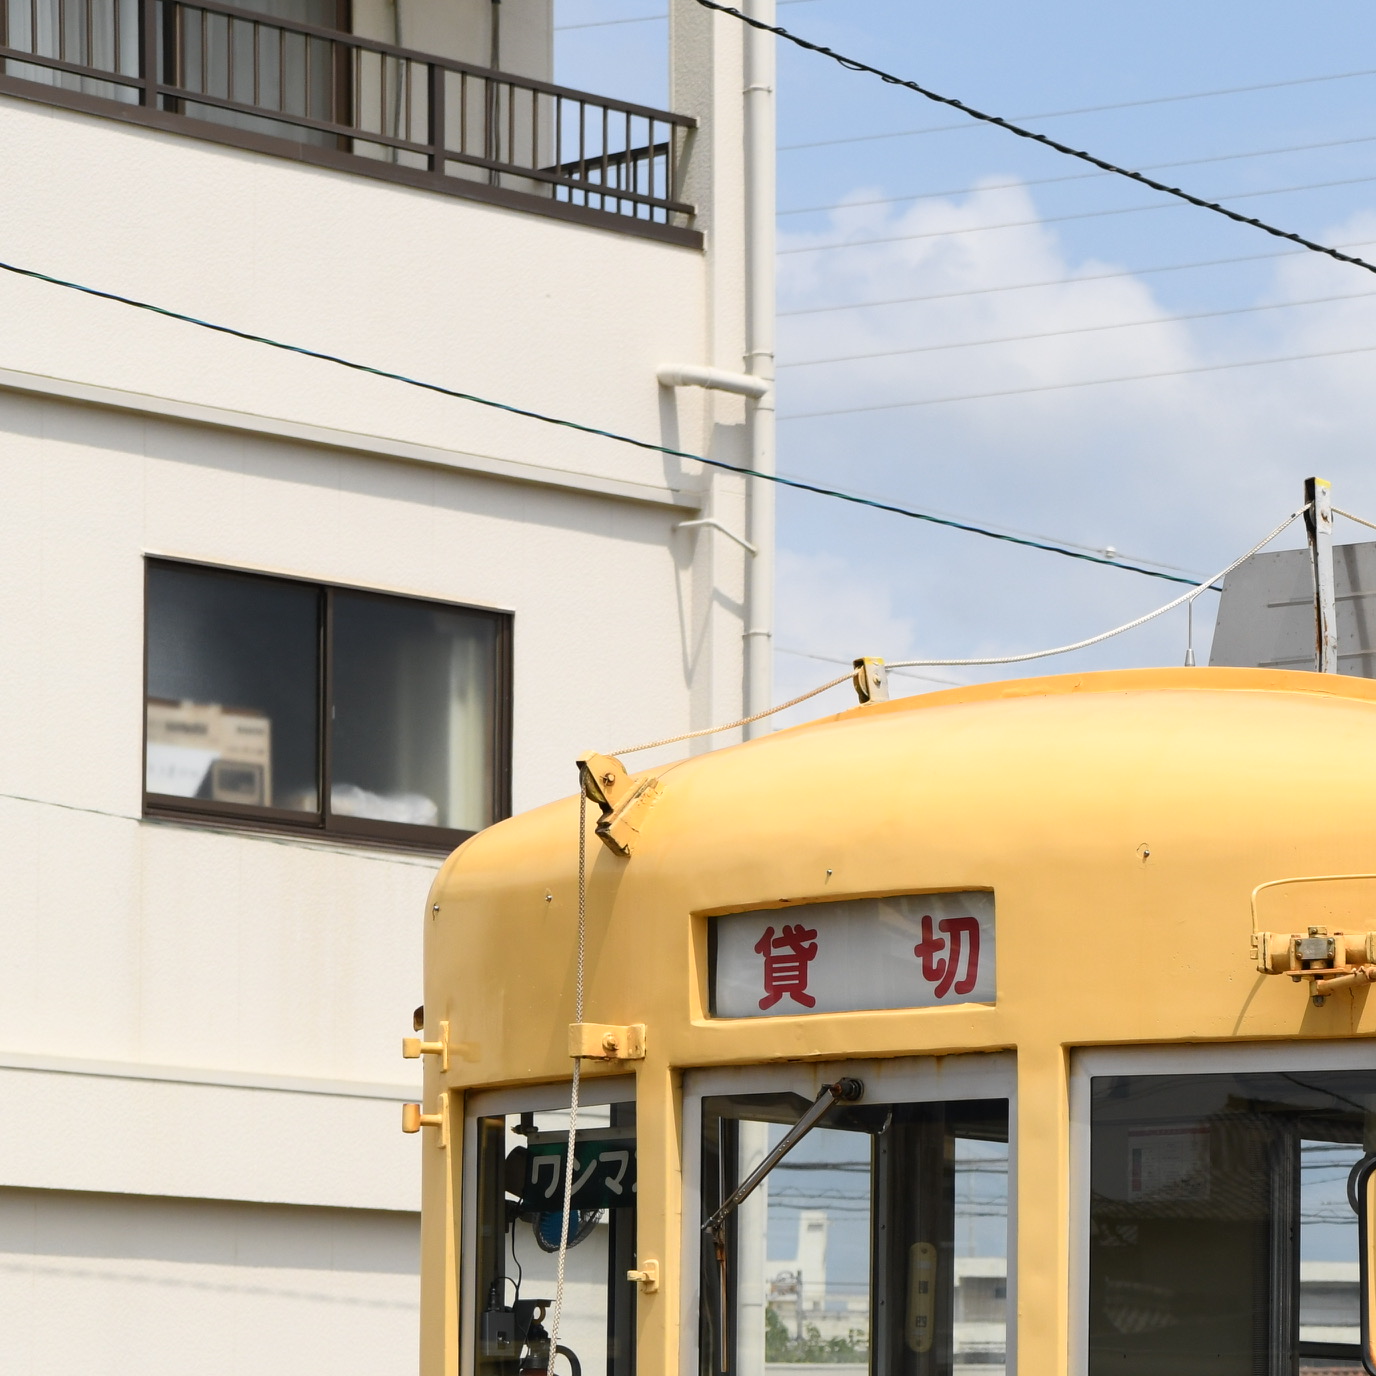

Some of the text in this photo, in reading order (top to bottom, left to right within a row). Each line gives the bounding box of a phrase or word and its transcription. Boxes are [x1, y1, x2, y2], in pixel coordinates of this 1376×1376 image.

[754, 915, 980, 1010] 貸切
[531, 1150, 638, 1198] ワンマ
